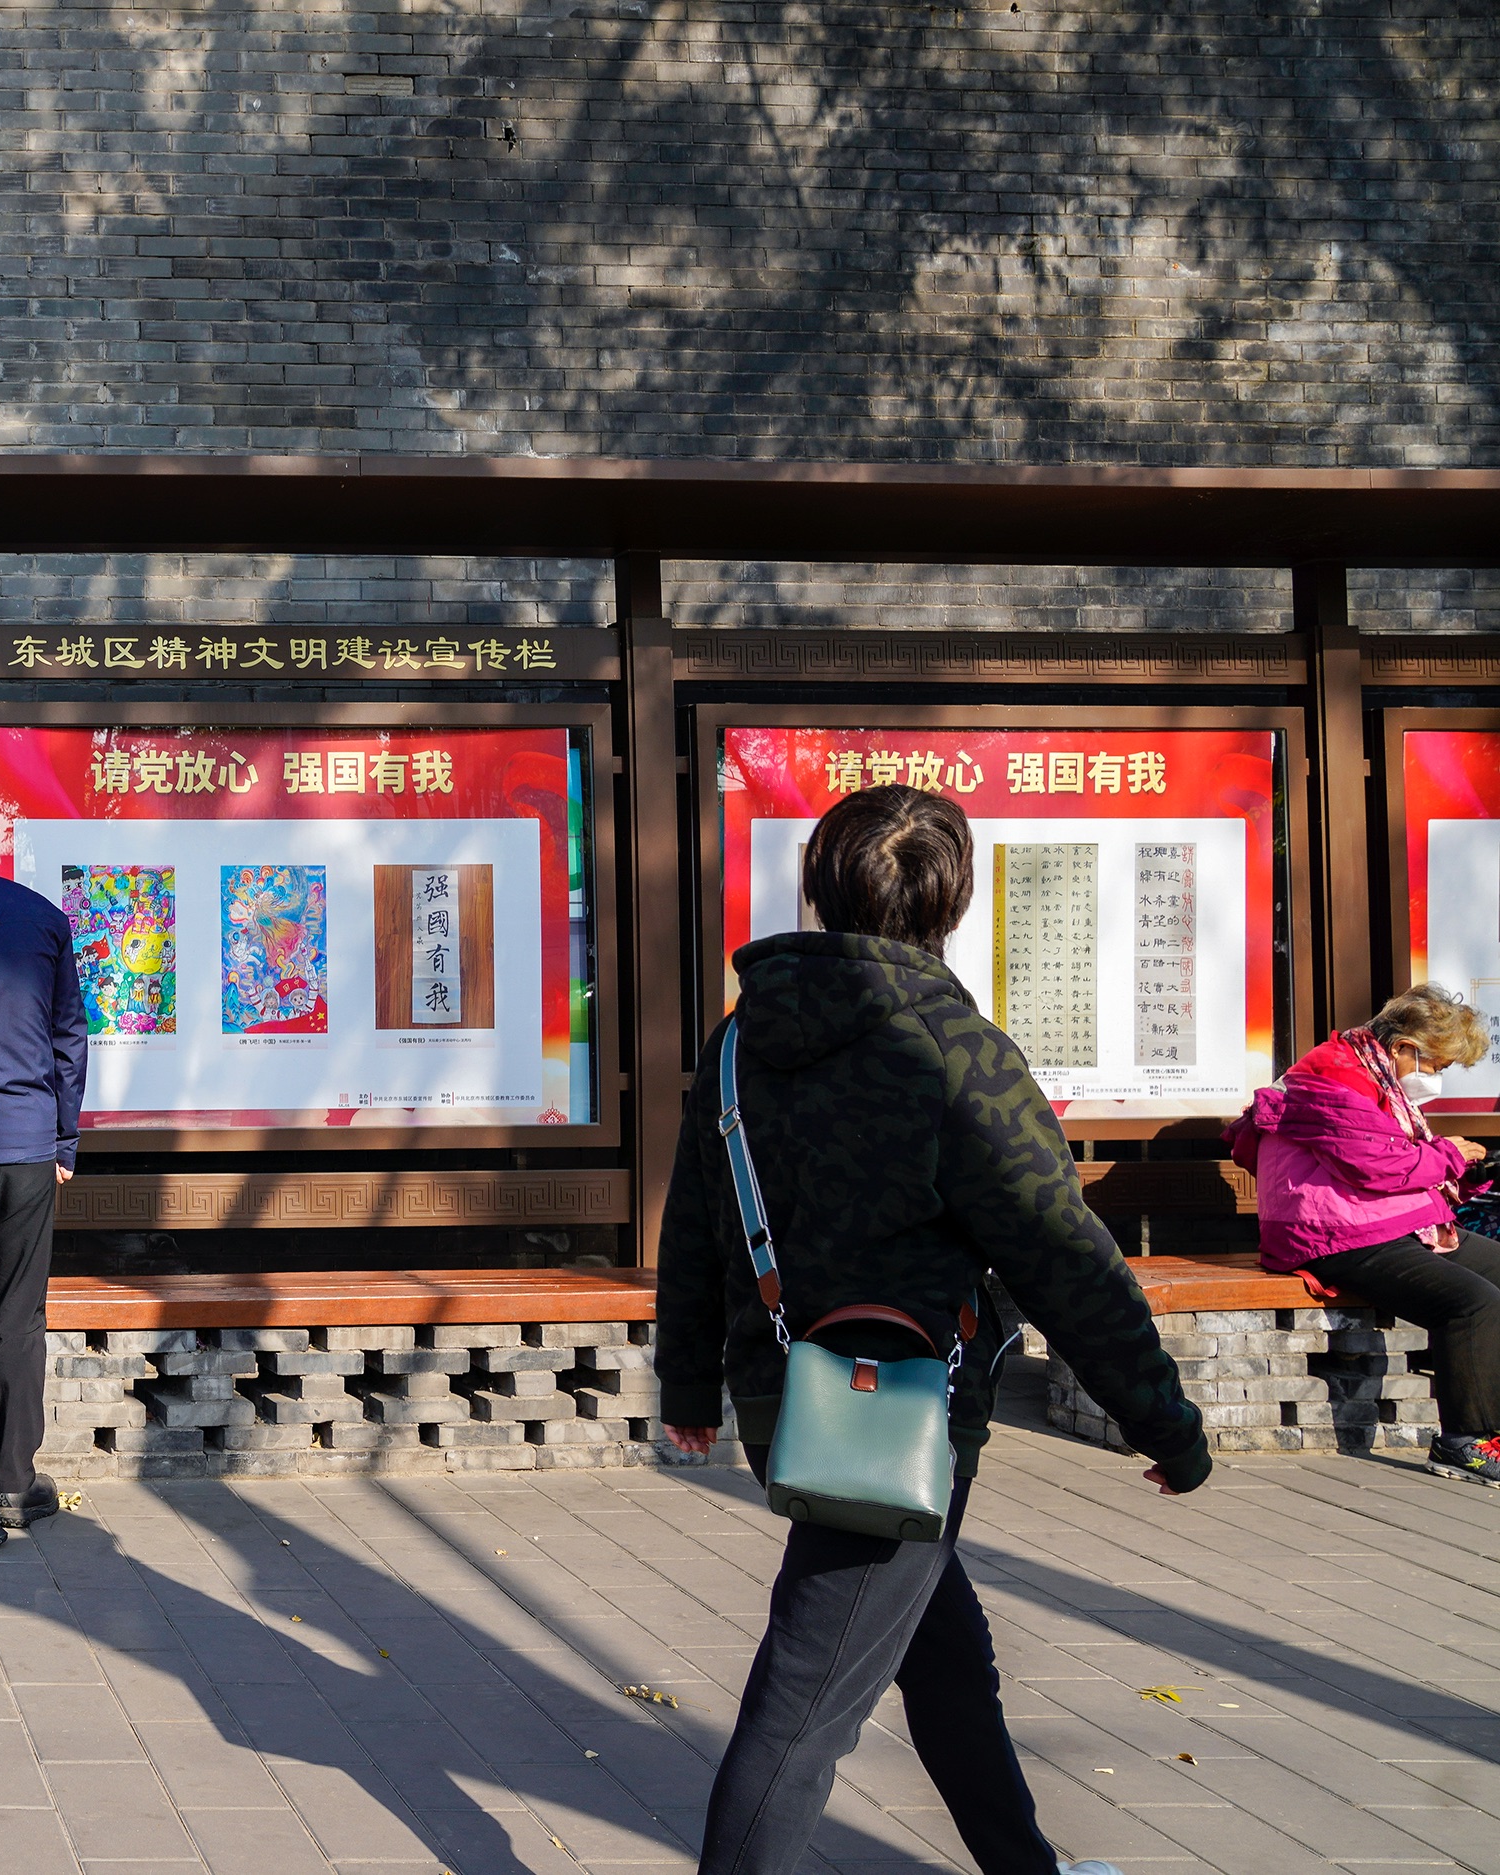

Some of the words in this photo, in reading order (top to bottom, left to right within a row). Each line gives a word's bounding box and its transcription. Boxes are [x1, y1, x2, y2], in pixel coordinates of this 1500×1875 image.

[7, 635, 557, 671] 东城区精神文明建设宣传栏
[91, 750, 259, 795] 请党放心
[283, 750, 455, 795] 强国有我
[825, 750, 985, 794] 请党放心
[1006, 751, 1167, 795] 强国有我
